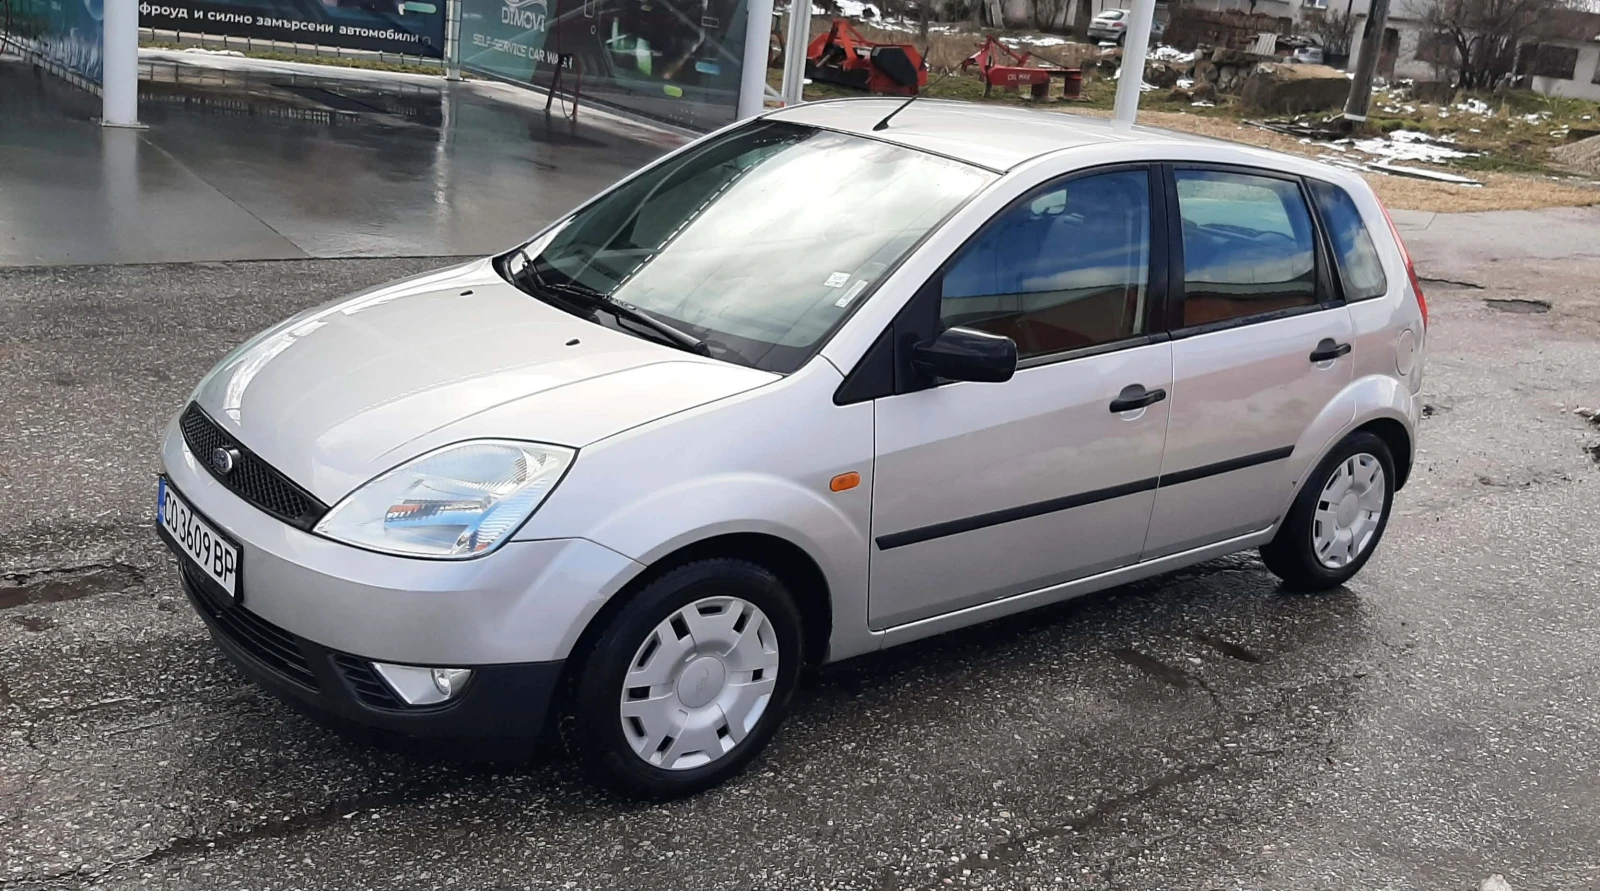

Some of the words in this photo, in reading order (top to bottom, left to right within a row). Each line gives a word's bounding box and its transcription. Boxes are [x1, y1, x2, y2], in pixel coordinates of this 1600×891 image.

[139, 0, 188, 19] фроуд
[194, 9, 203, 19] и
[207, 9, 253, 25] силно
[256, 15, 334, 34] замърсени
[339, 24, 419, 43] автомобили
[501, 6, 545, 33] DIMOVI
[472, 33, 527, 57] SELF-SERVICE
[528, 47, 545, 62] CAR
